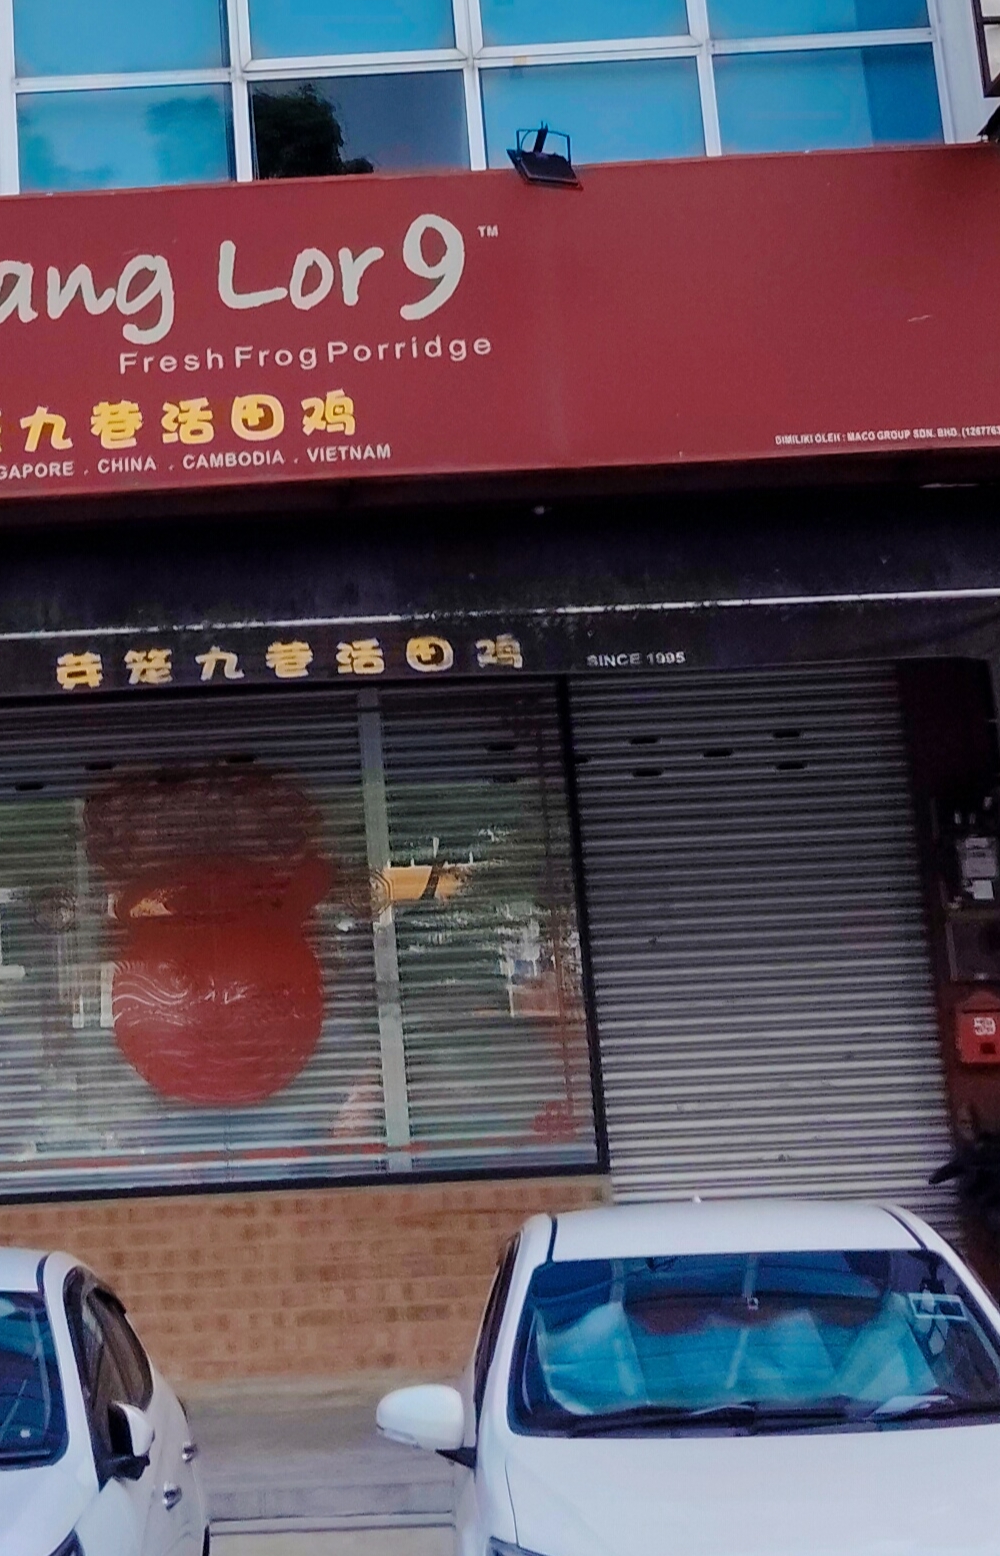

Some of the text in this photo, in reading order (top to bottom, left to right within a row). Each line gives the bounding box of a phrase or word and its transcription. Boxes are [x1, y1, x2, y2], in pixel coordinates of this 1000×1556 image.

[218, 239, 385, 311] Lor
[400, 213, 466, 321] 9
[119, 335, 494, 375] Fresh Frog Porridge
[877, 429, 911, 441] GROUP
[97, 457, 158, 474] CHINA
[182, 450, 286, 471] CAMBODIA
[306, 444, 392, 462] VIETNAM
[586, 651, 686, 667] SINCE 1995
